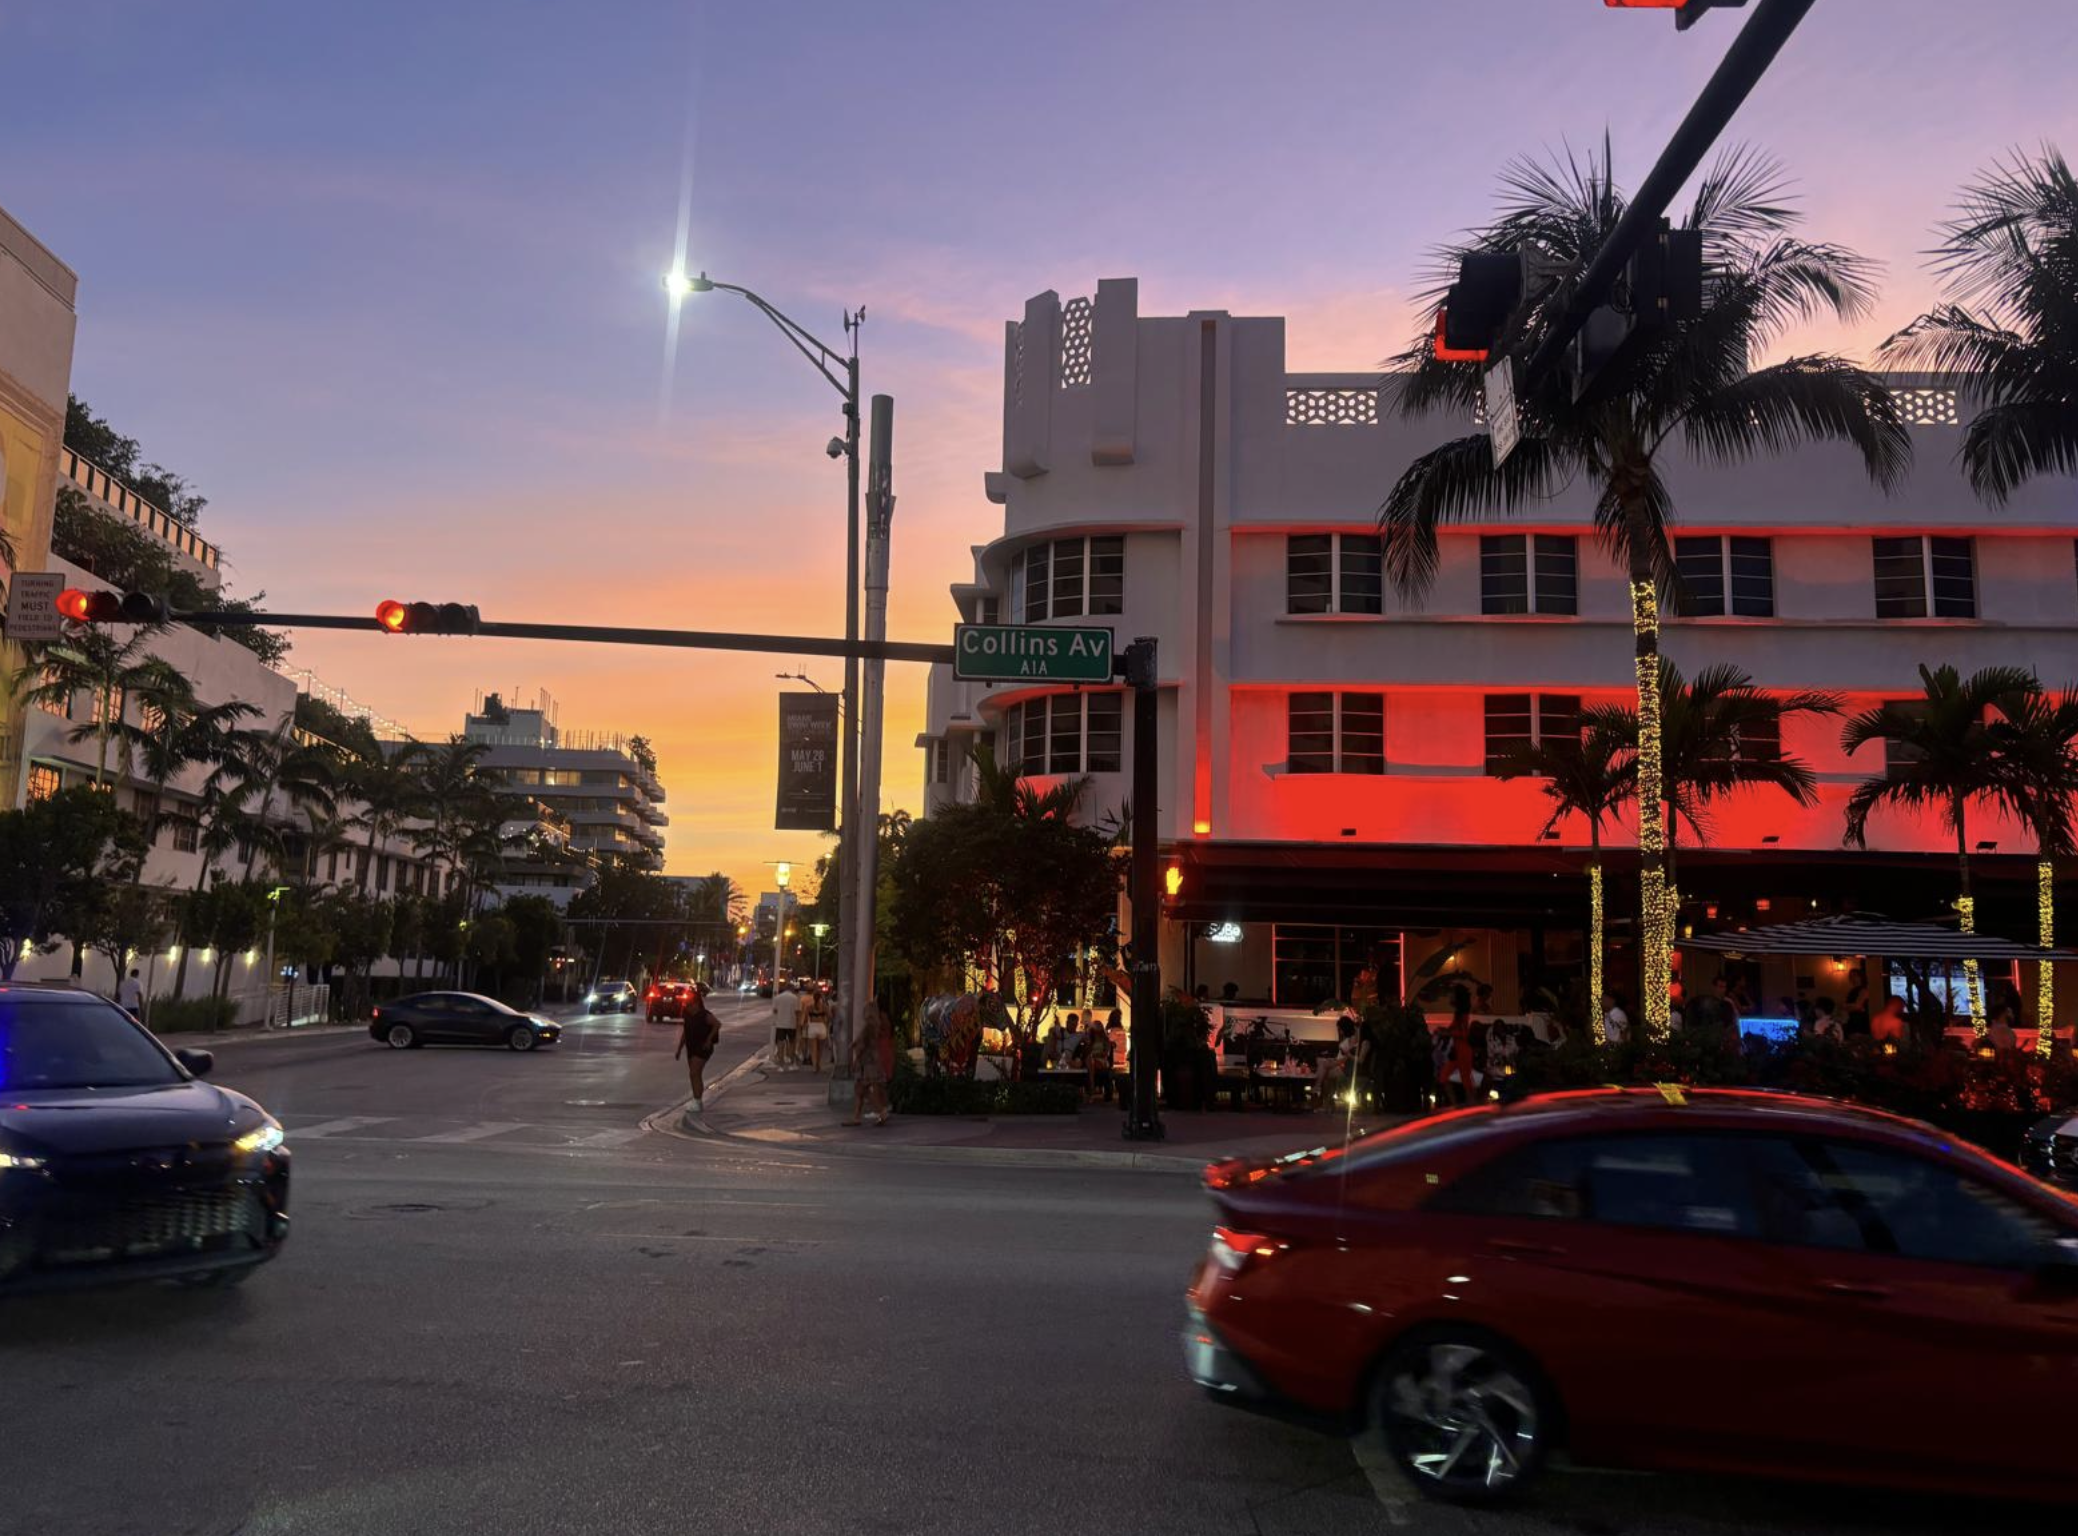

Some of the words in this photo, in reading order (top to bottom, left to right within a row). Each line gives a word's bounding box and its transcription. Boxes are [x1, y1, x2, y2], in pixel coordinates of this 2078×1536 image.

[21, 580, 54, 588] TURNING
[20, 590, 51, 599] TRAFFIC
[21, 601, 50, 611] MUST
[963, 630, 1059, 656] Collins
[1068, 633, 1105, 657] Av
[1020, 659, 1048, 676] A1A
[810, 720, 832, 730] WEEK
[791, 749, 811, 761] MAY
[812, 749, 825, 761] 28
[792, 761, 815, 773] JUNE
[817, 761, 822, 773] 1
